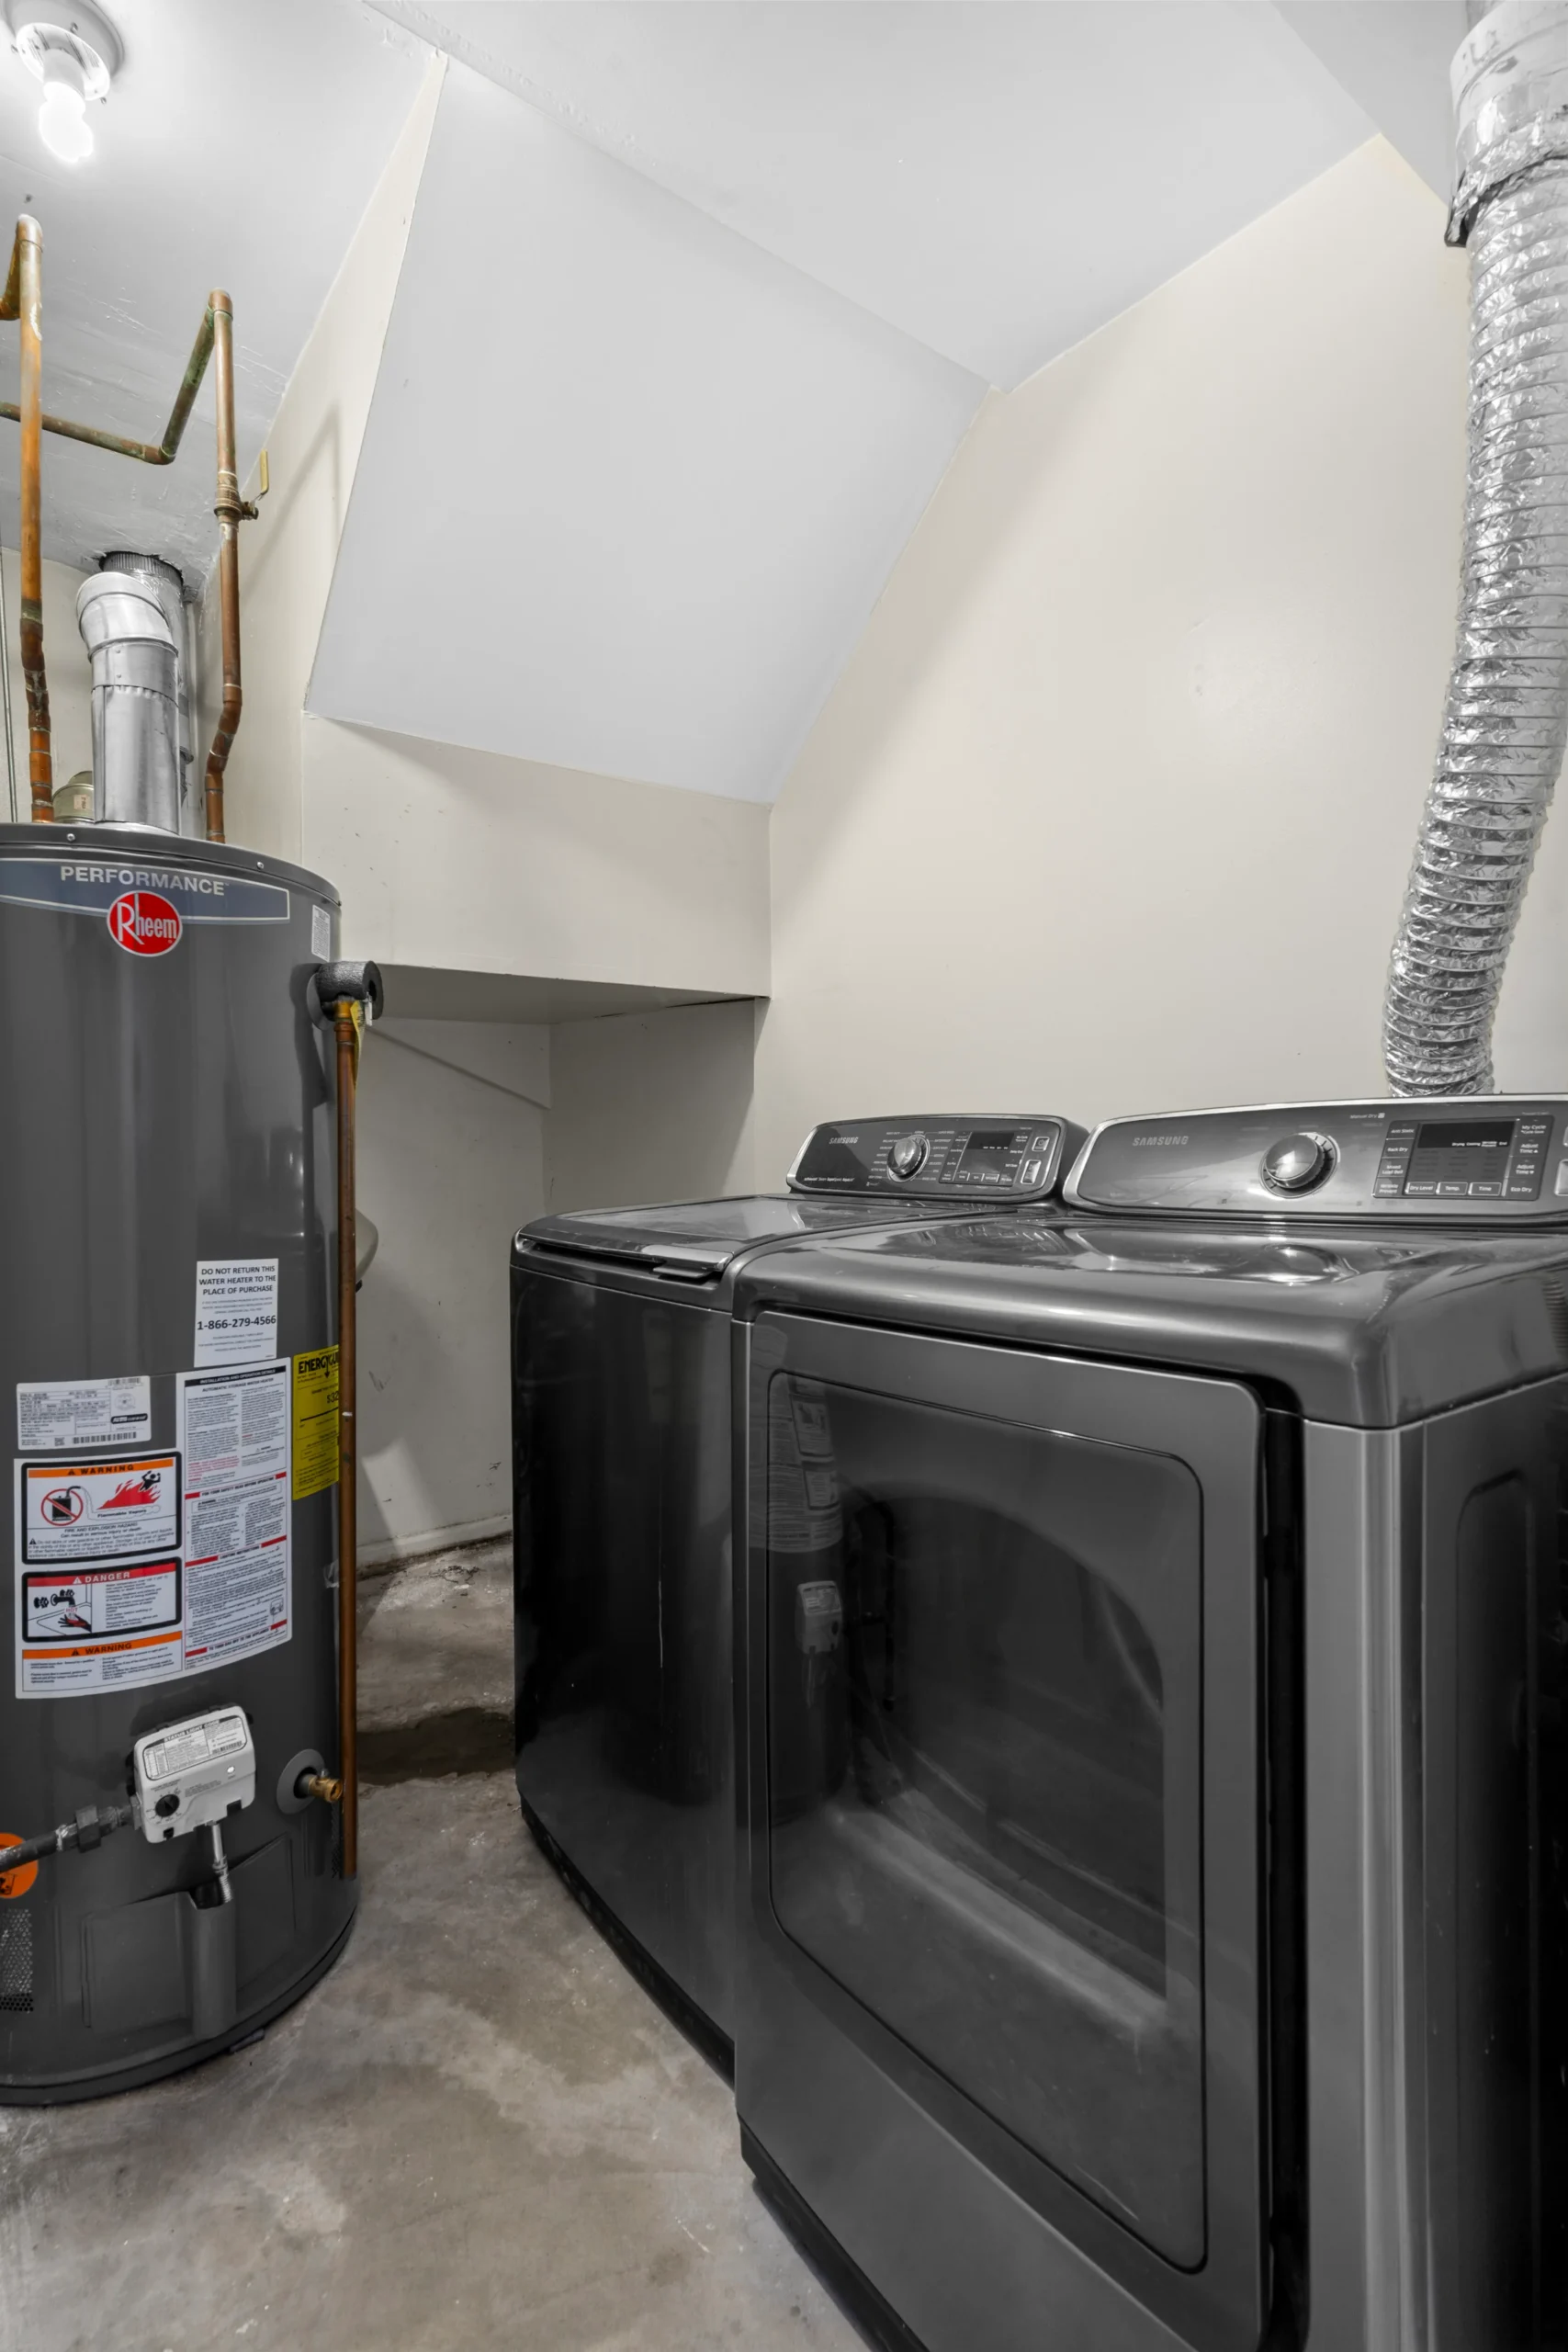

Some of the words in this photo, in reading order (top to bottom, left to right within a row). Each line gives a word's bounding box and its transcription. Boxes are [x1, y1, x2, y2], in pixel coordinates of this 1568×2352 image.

[61, 866, 225, 896] PERFORMANCE
[117, 893, 177, 945] Rheem
[829, 1136, 859, 1145] SAMSUNG
[1132, 1136, 1190, 1147] SAMSUNG
[227, 1276, 253, 1284] HEATER
[239, 1284, 273, 1293] PURCHASE
[197, 1315, 276, 1330] 1-866-279-4566
[80, 1464, 134, 1475] WARNING
[85, 1571, 130, 1583] DANGER
[85, 1643, 132, 1654] WARNING
